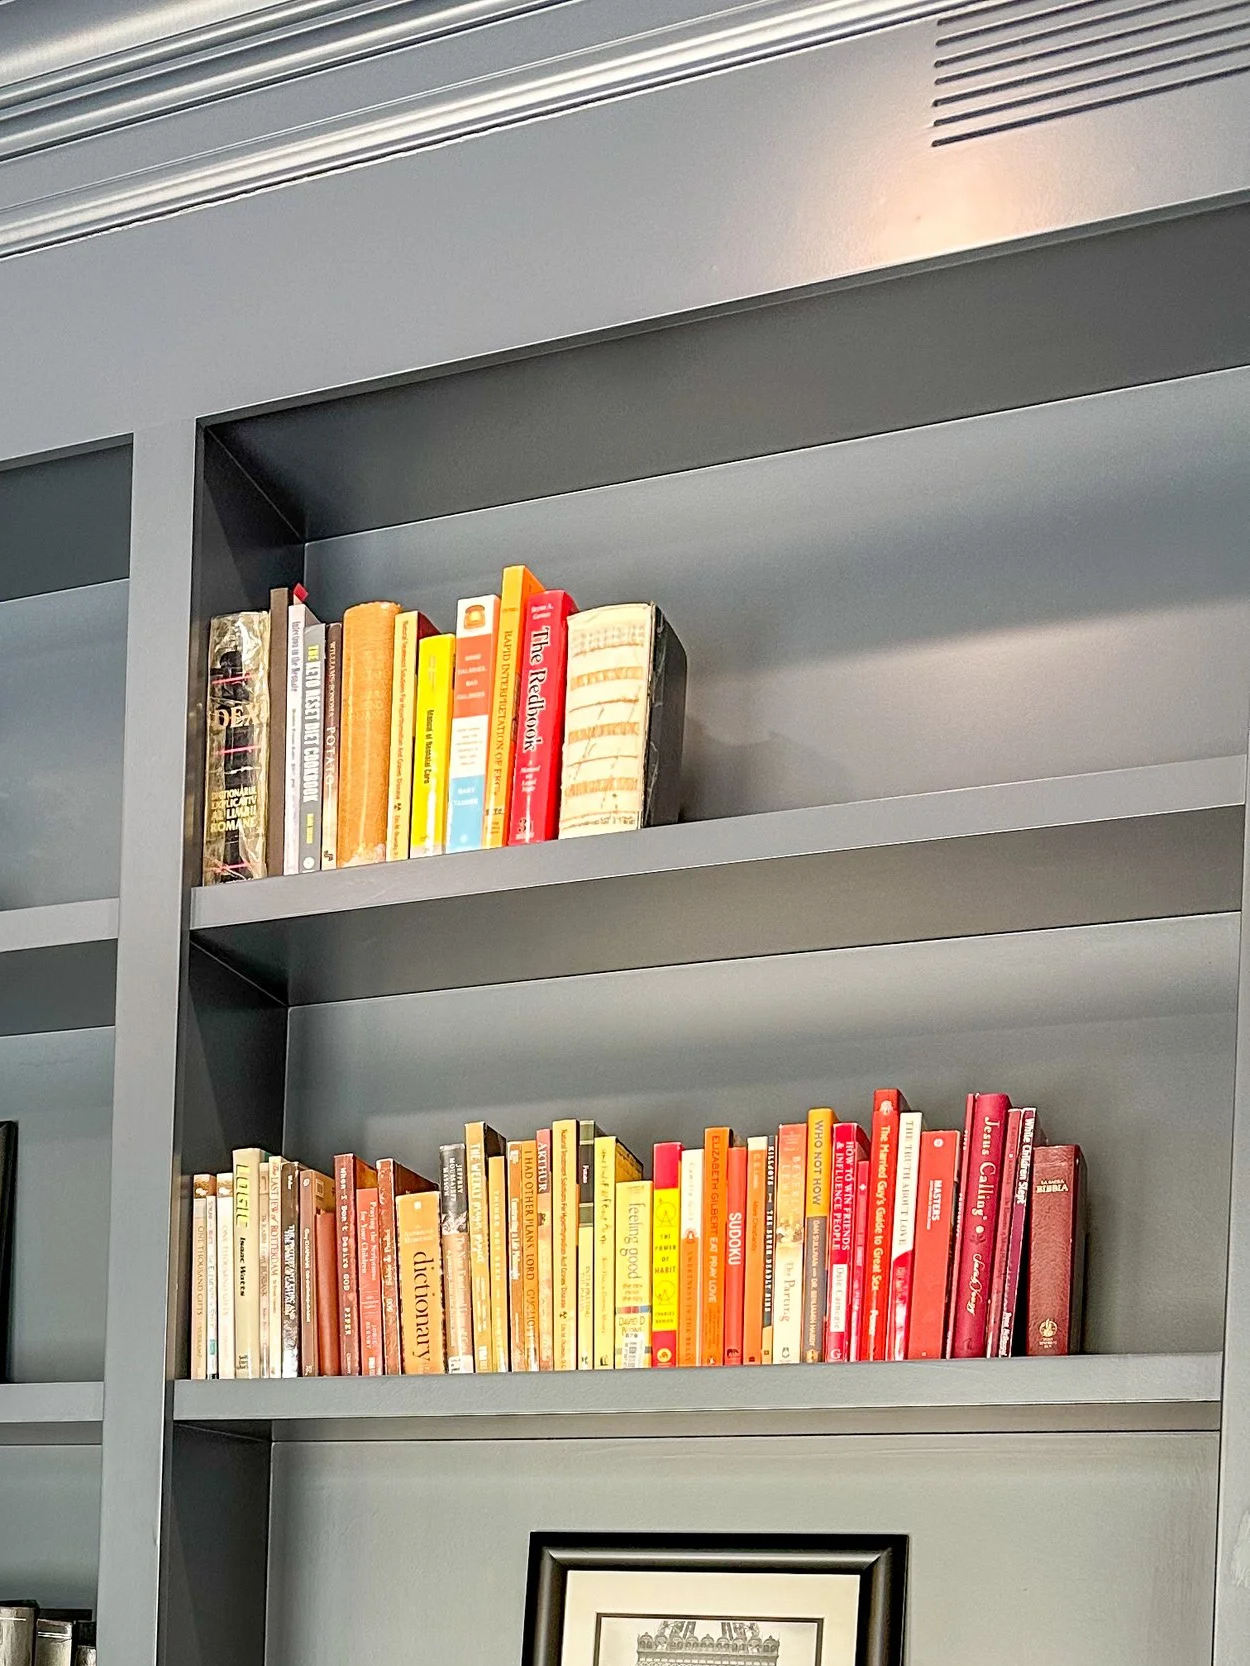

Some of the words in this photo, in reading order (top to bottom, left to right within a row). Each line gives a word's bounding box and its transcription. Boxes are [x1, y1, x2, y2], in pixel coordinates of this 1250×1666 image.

[502, 630, 512, 662] RAPID
[530, 627, 550, 662] The
[306, 662, 321, 688] KETO
[214, 703, 261, 730] DEX
[305, 689, 319, 721] RESET
[496, 664, 510, 750] INTERPRETATION
[524, 669, 546, 752] Redbook
[304, 724, 318, 745] DIET
[326, 726, 335, 785] POTATO
[496, 752, 502, 766] OF
[303, 747, 318, 803] COOKBOOK
[813, 1120, 823, 1148] WHO
[880, 1125, 891, 1142] The
[980, 1116, 1000, 1156] Jesus
[1022, 1118, 1035, 1142] While
[471, 1143, 482, 1162] THE
[524, 1155, 532, 1179] HAD
[538, 1141, 548, 1192] ARTHUR
[711, 1136, 721, 1190] ELIZABETH
[813, 1151, 823, 1175] NOT
[845, 1141, 854, 1162] HOW
[876, 1144, 889, 1178] Married
[902, 1140, 913, 1175] TRUTH
[1019, 1145, 1033, 1179] Children
[271, 1177, 279, 1196] LAST
[471, 1163, 484, 1199] WEEKLY
[833, 1152, 844, 1209] INFLUENCE
[844, 1165, 853, 1178] TO
[236, 1165, 250, 1227] LOGIC
[525, 1181, 533, 1216] OTHER
[812, 1178, 822, 1206] HOW
[844, 1182, 852, 1204] WIN
[874, 1180, 887, 1205] Guy's
[899, 1178, 911, 1215] ABOUT
[931, 1180, 942, 1221] MASTERS
[972, 1161, 998, 1216] Calling
[1015, 1182, 1029, 1205] Slept
[269, 1197, 279, 1214] JEW
[710, 1193, 720, 1236] GILBERT
[874, 1207, 885, 1233] Guide
[624, 1203, 644, 1244] feeling
[728, 1212, 742, 1265] SUDOKU
[832, 1212, 842, 1250] PEOPLE
[842, 1207, 851, 1250] FRIENDS
[898, 1218, 909, 1245] LOVE
[271, 1225, 279, 1276] ROTTERDAM
[710, 1237, 718, 1252] EAT
[874, 1235, 884, 1245] to
[526, 1254, 535, 1280] LORD
[619, 1248, 642, 1279] good
[655, 1266, 676, 1274] HABIT
[709, 1255, 717, 1277] PRAY
[872, 1247, 884, 1272] Great
[708, 1280, 717, 1303] LOVE
[871, 1274, 882, 1291] Sex
[412, 1251, 435, 1360] dictionary
[780, 1279, 794, 1322] Parting
